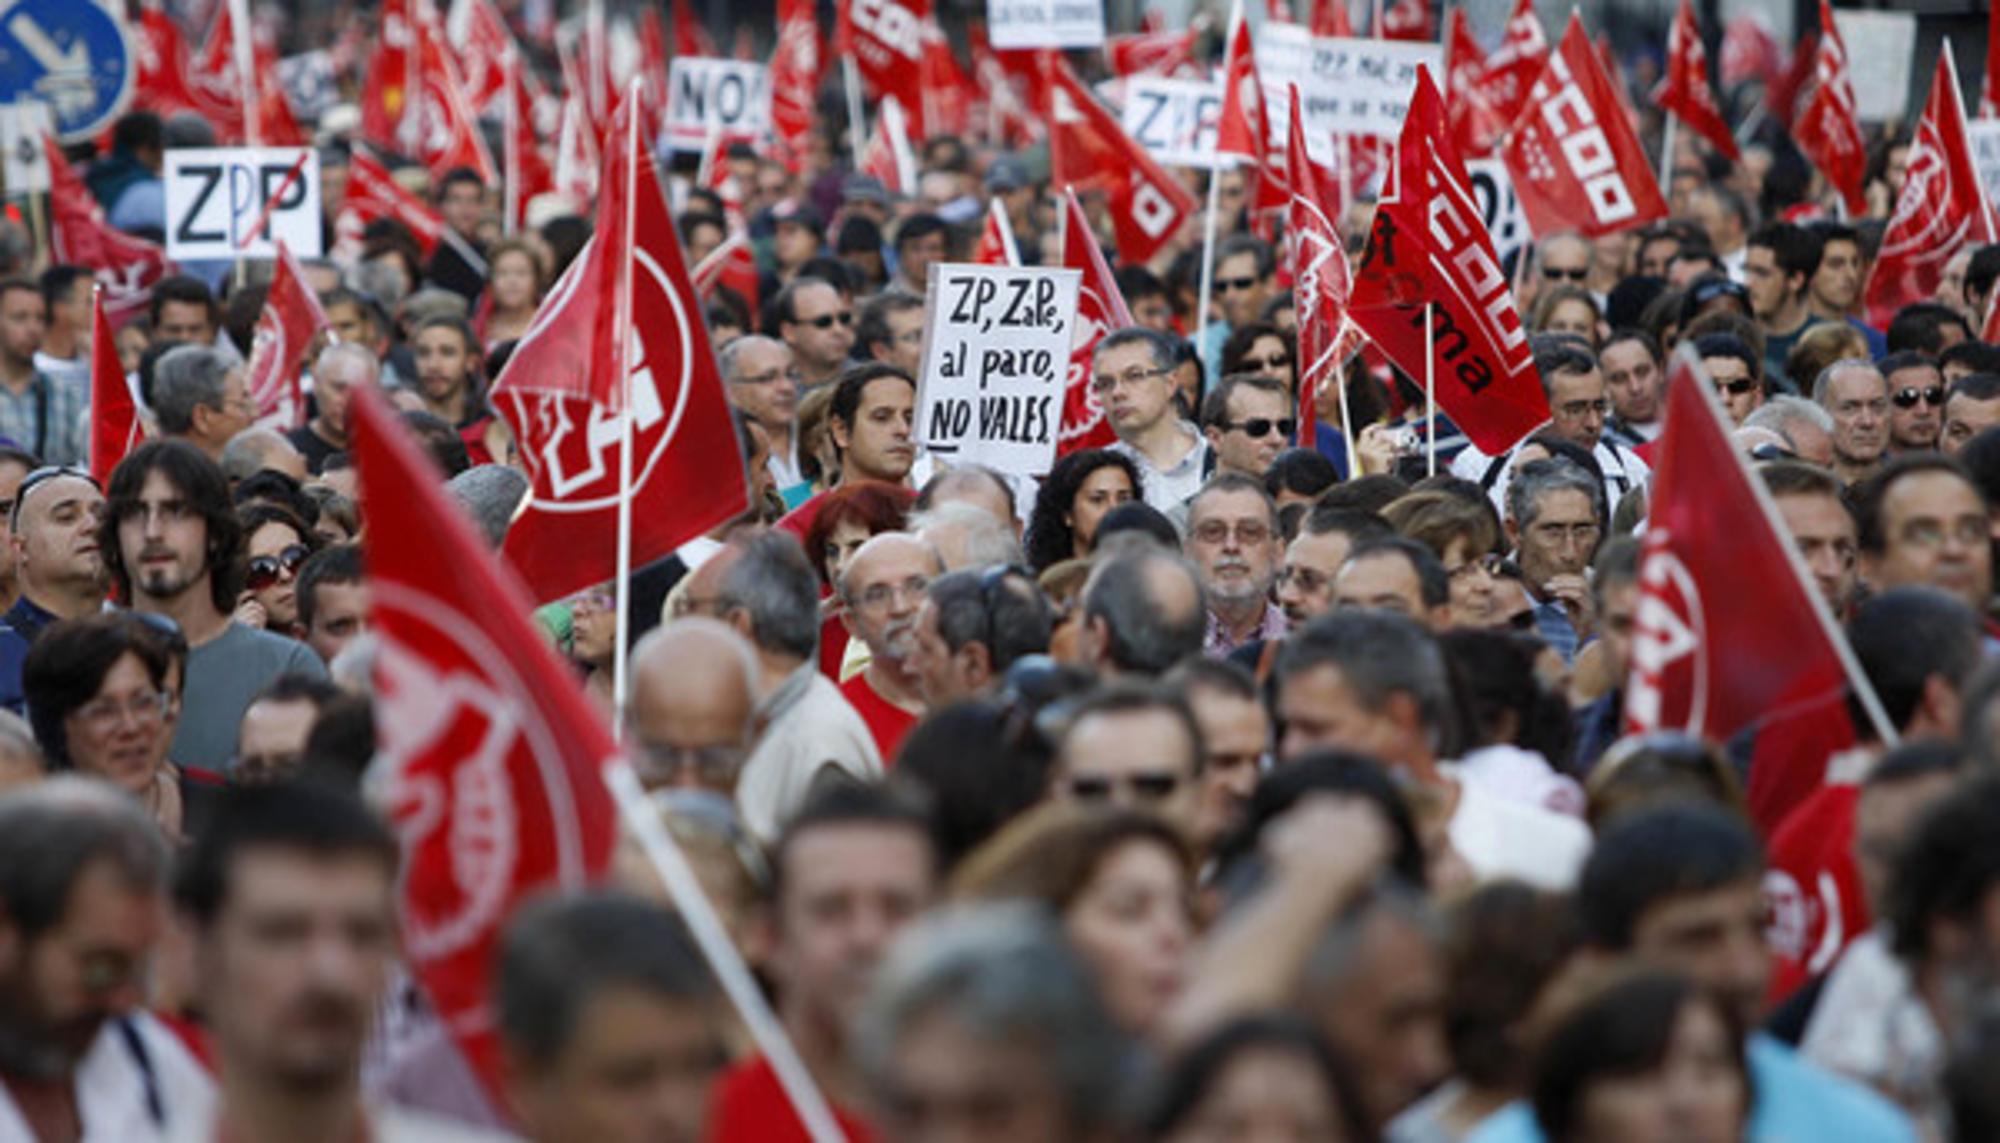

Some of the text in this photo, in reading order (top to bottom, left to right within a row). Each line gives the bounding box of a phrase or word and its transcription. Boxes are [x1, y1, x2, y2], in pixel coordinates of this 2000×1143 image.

[1427, 168, 1527, 350] COO
[950, 278, 996, 333] ZP,
[940, 341, 1055, 389] al paro,
[930, 399, 971, 439] NO
